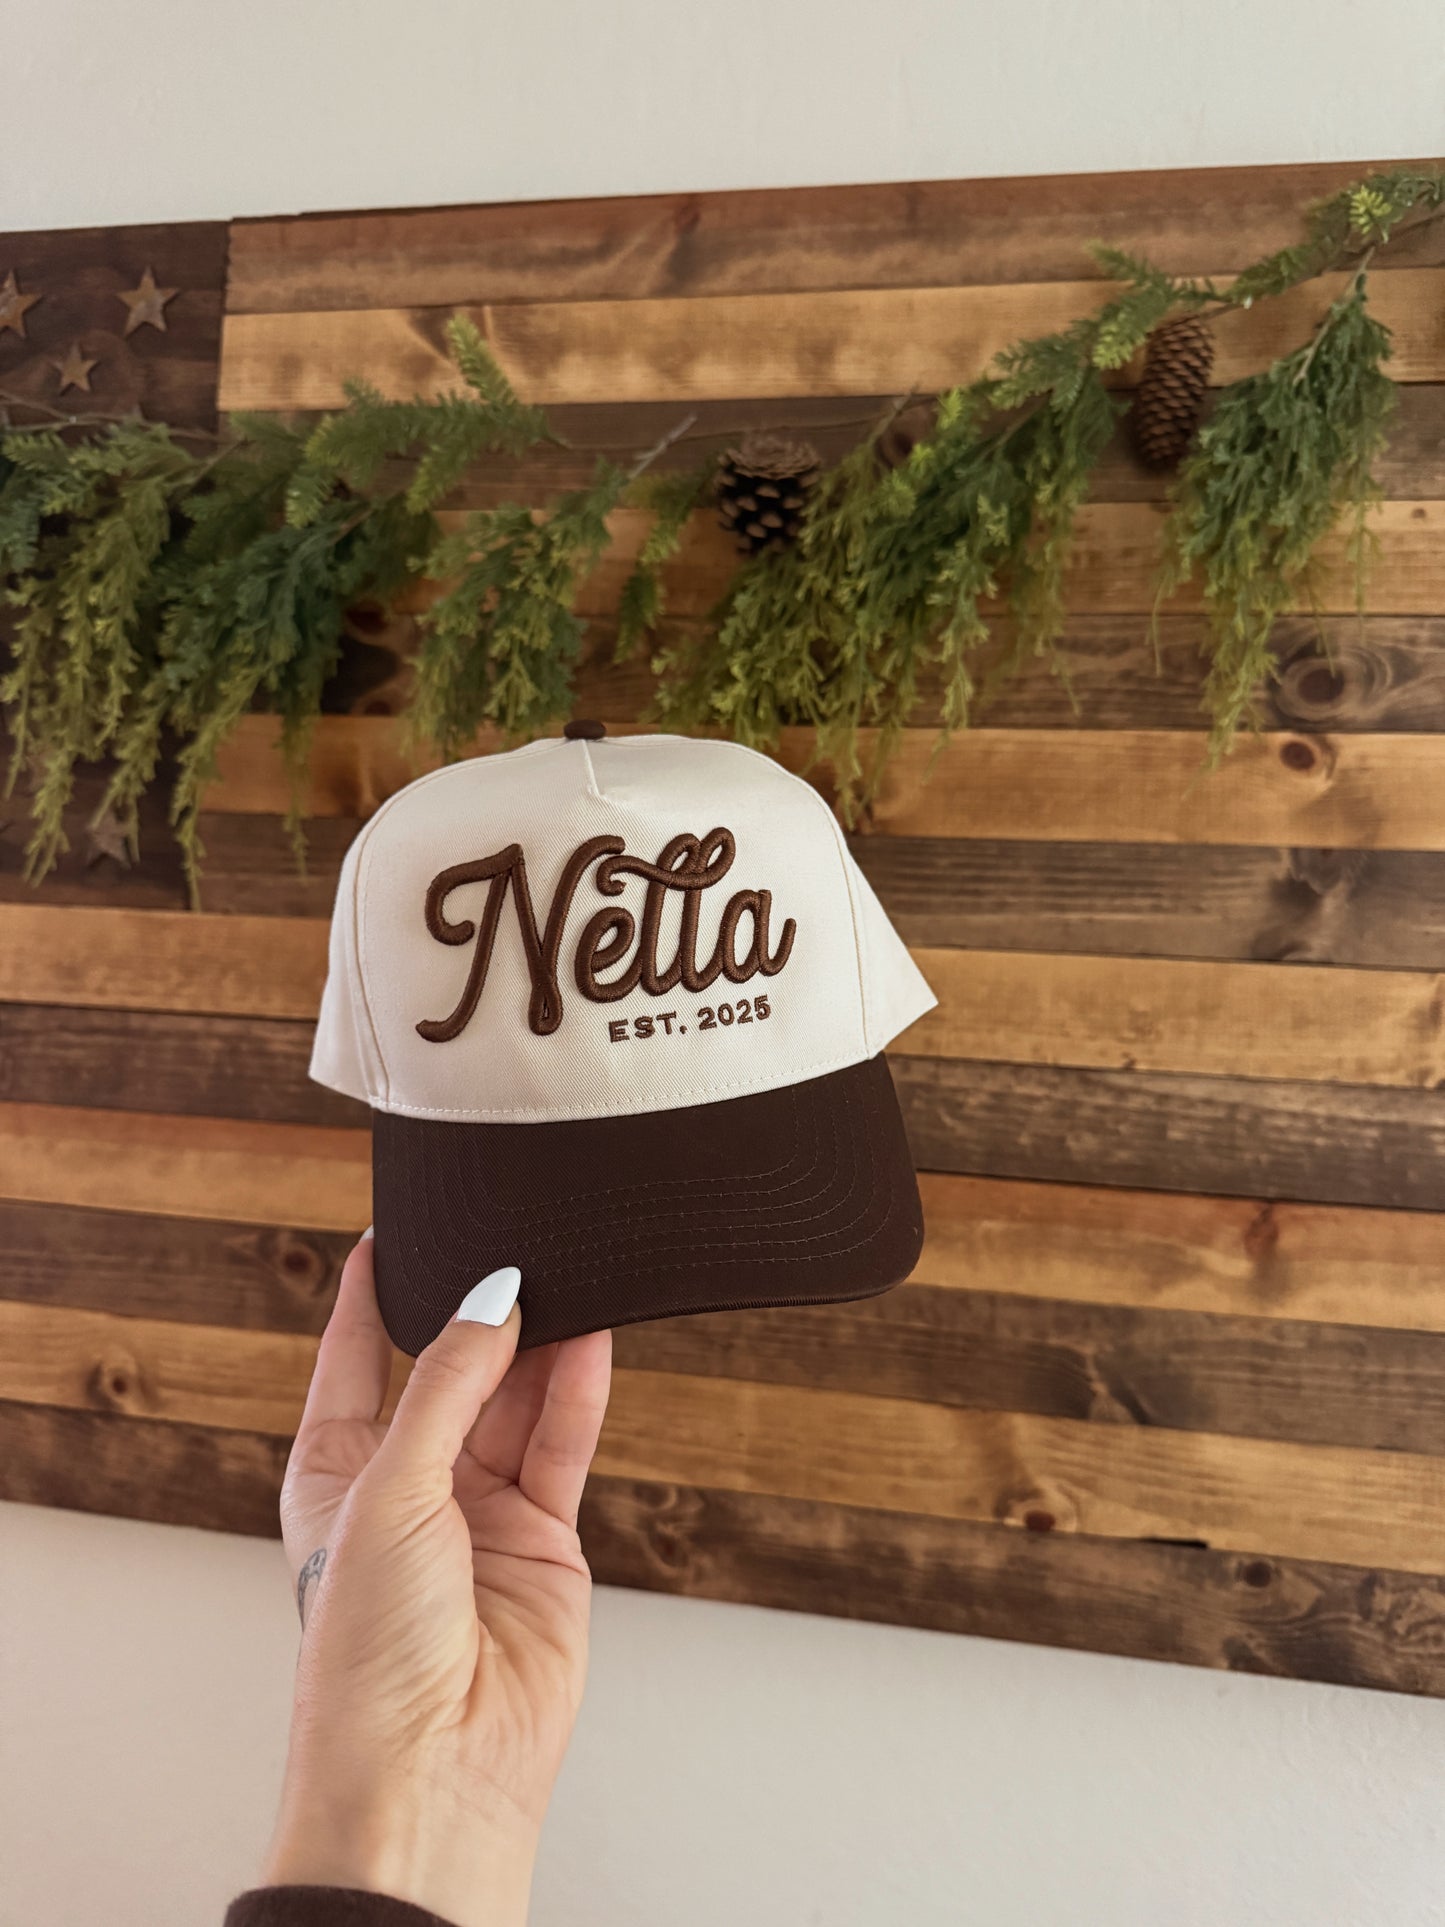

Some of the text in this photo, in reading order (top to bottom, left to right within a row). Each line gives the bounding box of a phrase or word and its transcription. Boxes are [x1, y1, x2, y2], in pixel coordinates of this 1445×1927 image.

[415, 826, 797, 1044] Netta
[608, 994, 771, 1043] EST. 2025
